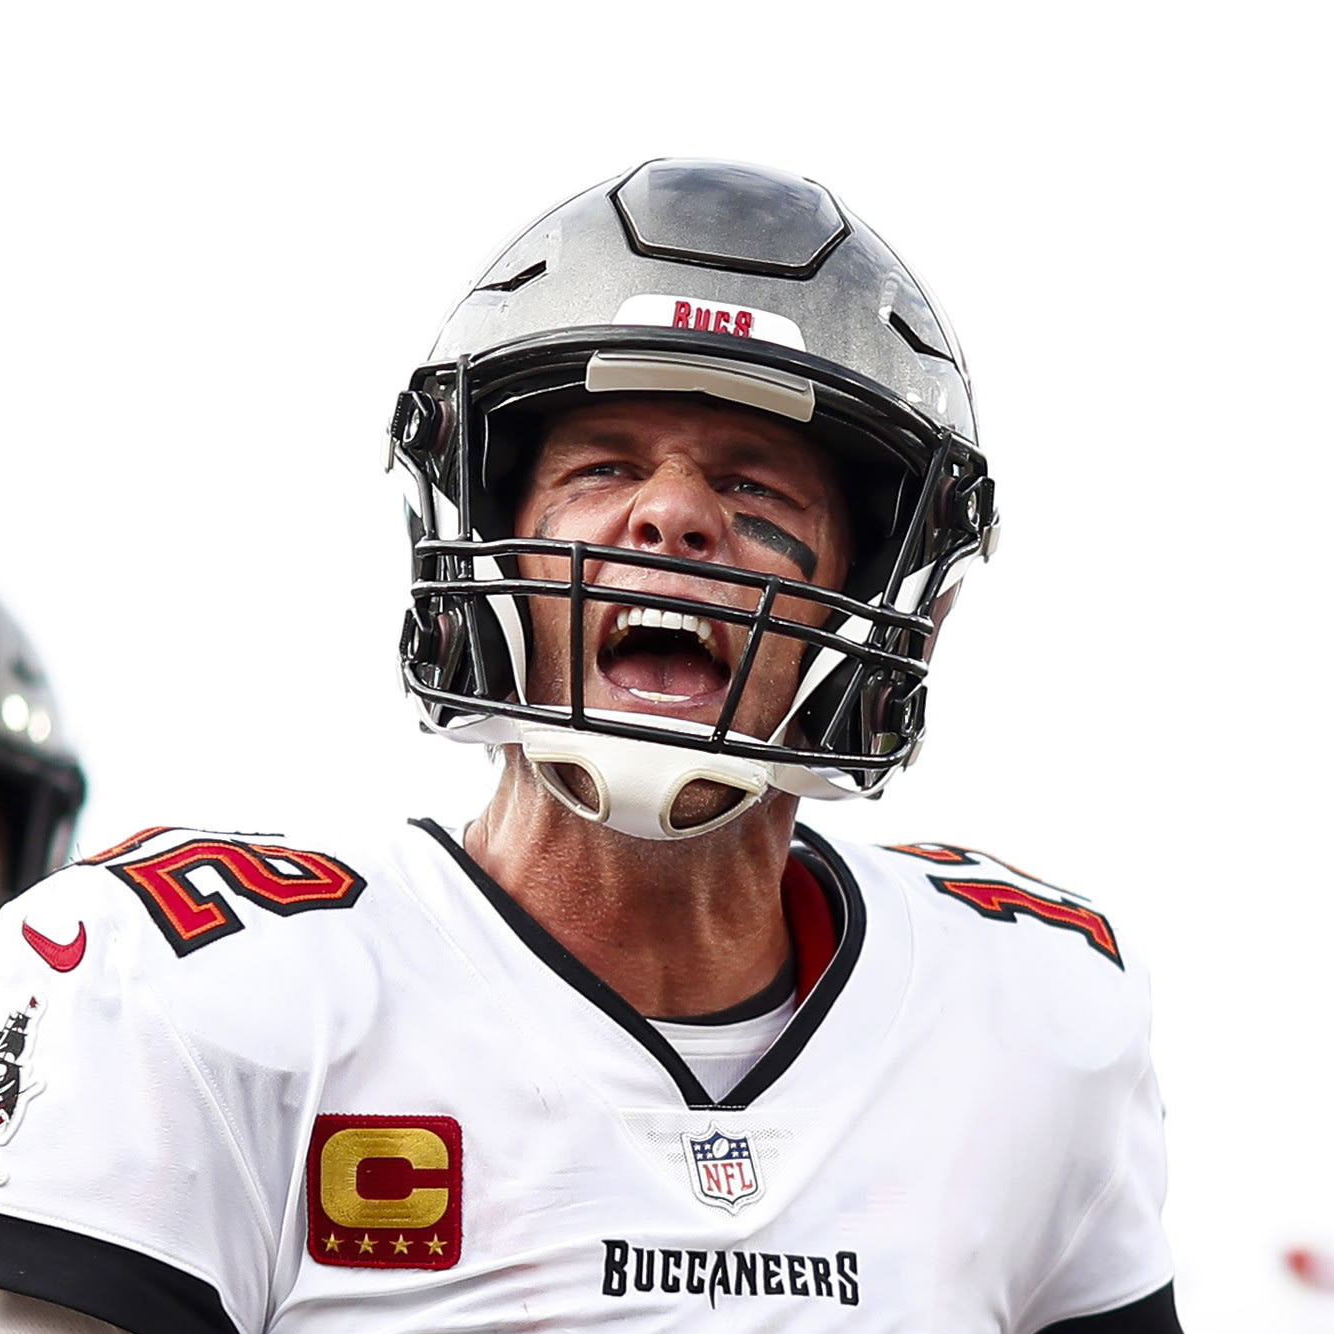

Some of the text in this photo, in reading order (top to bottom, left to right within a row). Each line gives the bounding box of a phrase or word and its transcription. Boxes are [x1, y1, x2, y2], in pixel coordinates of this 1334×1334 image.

[72, 826, 368, 959] 2
[320, 1128, 449, 1229] C
[702, 1162, 754, 1196] NFL
[601, 1239, 860, 1310] BUCCANEERS
